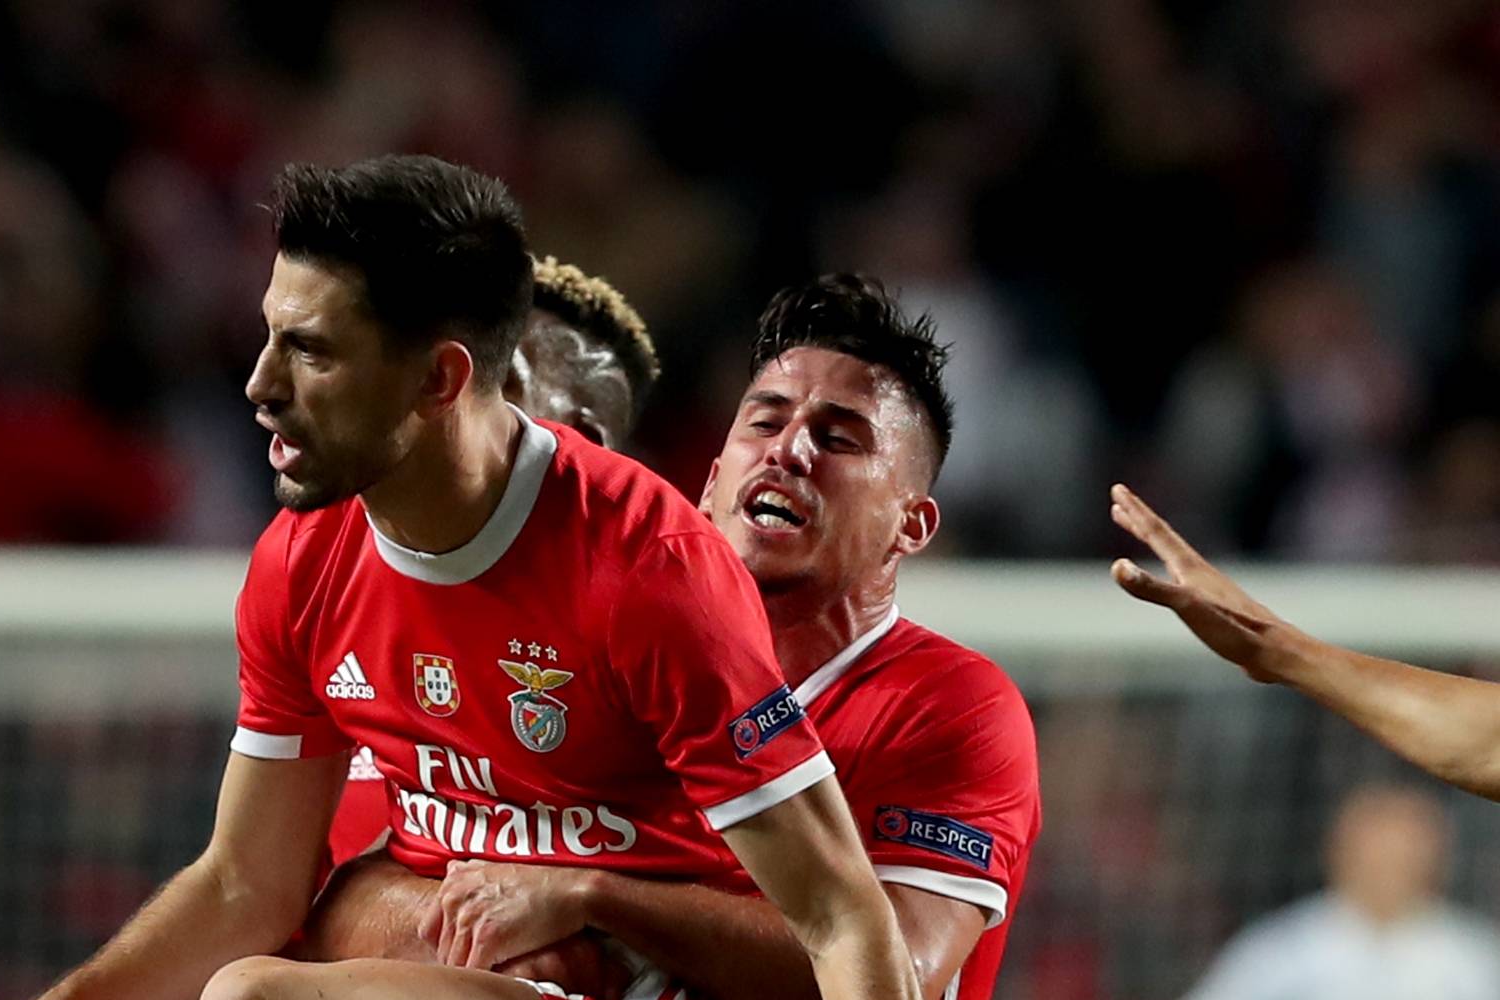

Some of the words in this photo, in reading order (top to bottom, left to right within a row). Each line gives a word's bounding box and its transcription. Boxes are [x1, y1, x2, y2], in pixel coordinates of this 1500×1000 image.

[326, 683, 375, 700] adidas
[757, 694, 799, 732] RESP
[415, 744, 498, 797] Fly
[396, 788, 637, 856] mirates
[911, 821, 991, 860] RESPECT
